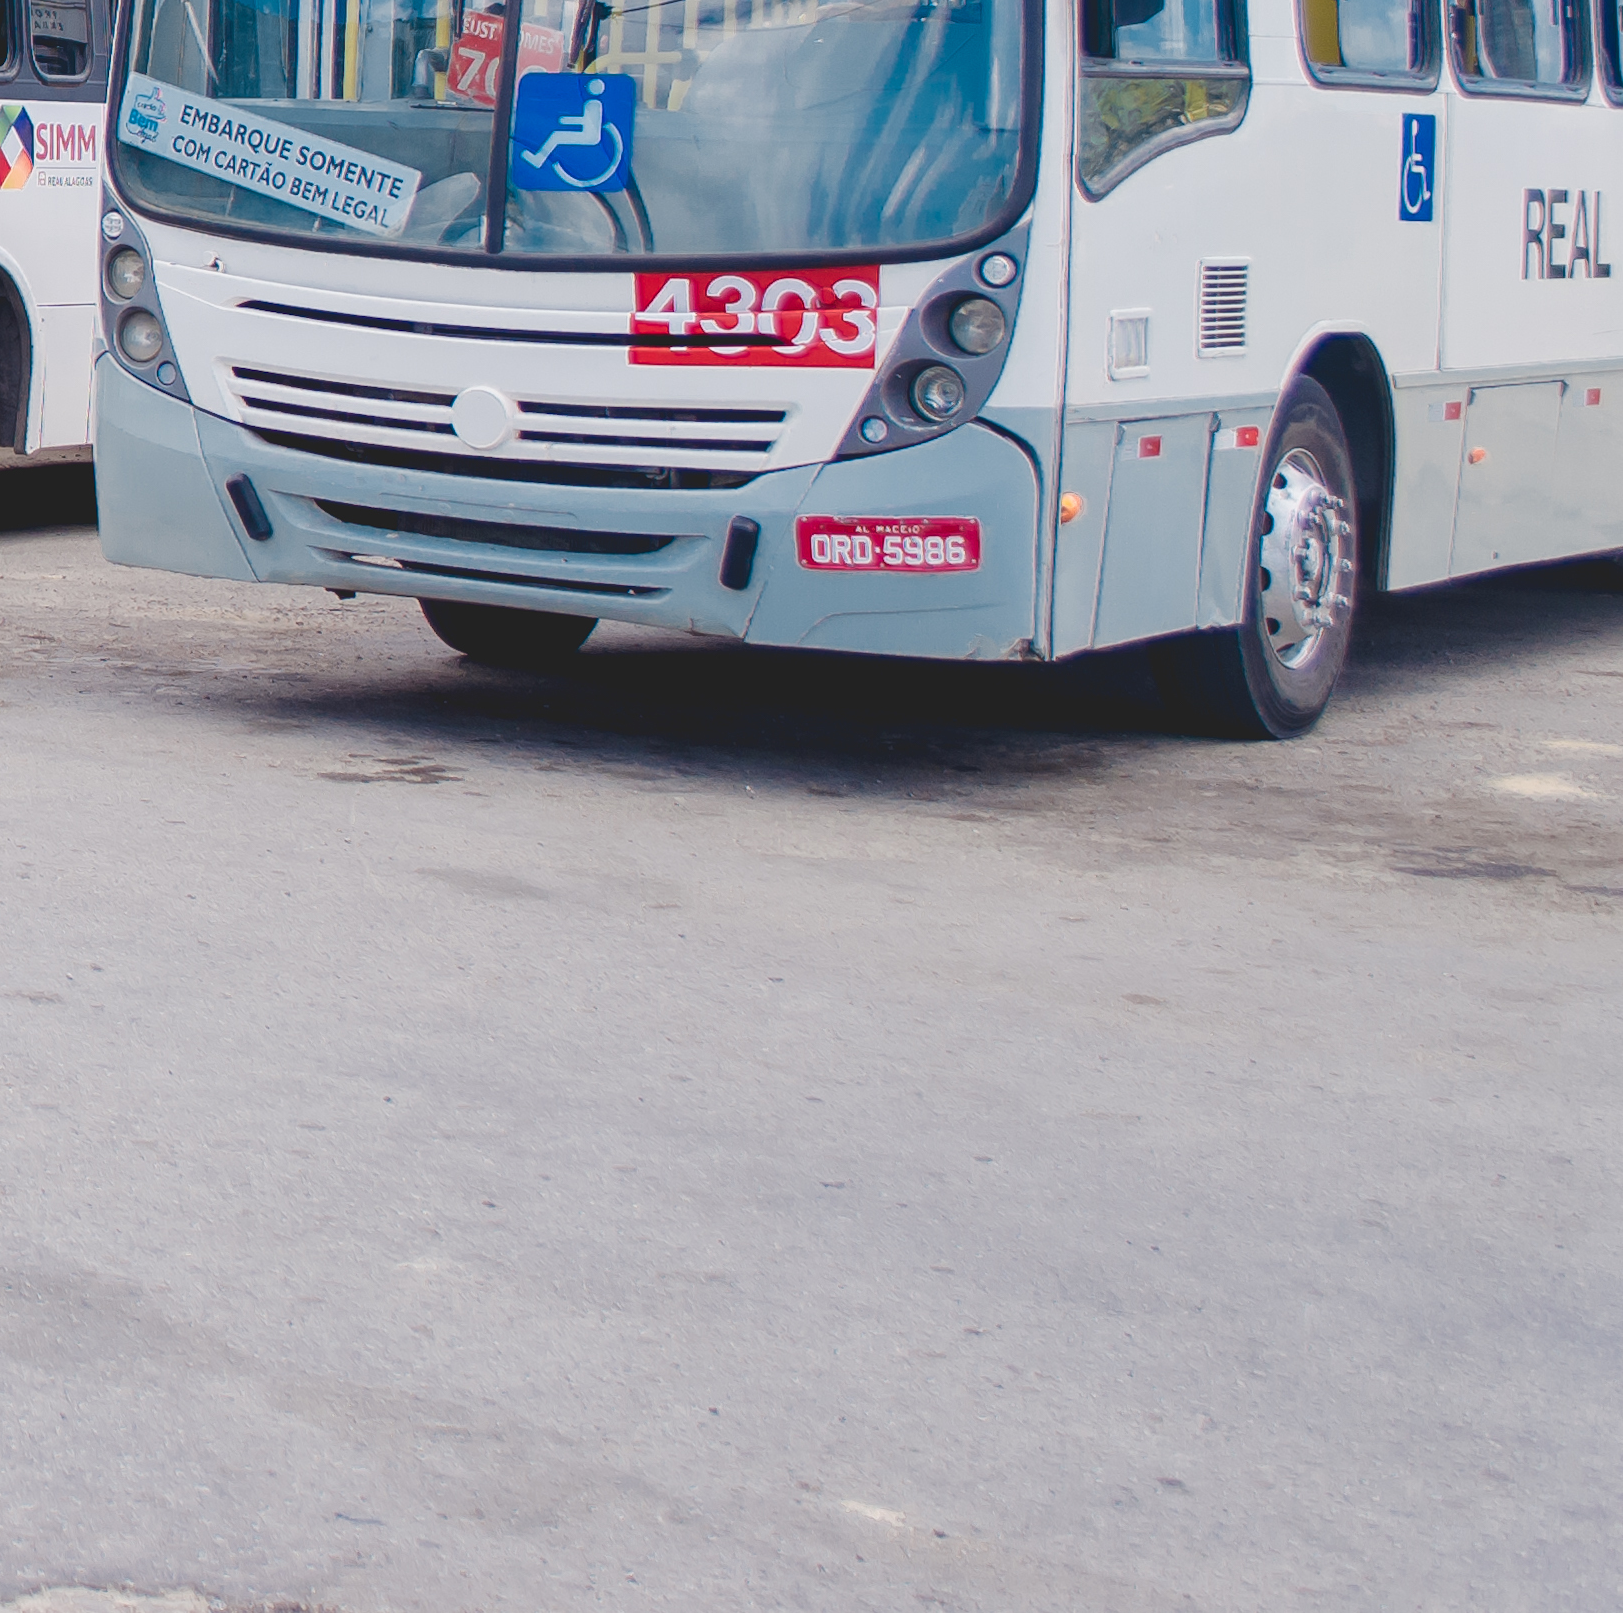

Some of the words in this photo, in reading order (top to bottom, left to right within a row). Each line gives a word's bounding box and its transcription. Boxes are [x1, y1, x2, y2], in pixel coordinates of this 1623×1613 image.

[35, 122, 97, 161] SIMM
[128, 108, 159, 132] Bem
[179, 103, 294, 161] EMBARQUE
[295, 145, 404, 200] SOMENTE
[171, 134, 211, 164] COM
[214, 149, 287, 190] CARTÃO
[289, 176, 330, 207] BEM
[330, 192, 389, 228] LEGAL
[1521, 188, 1611, 280] REAL
[635, 275, 877, 355] 4303
